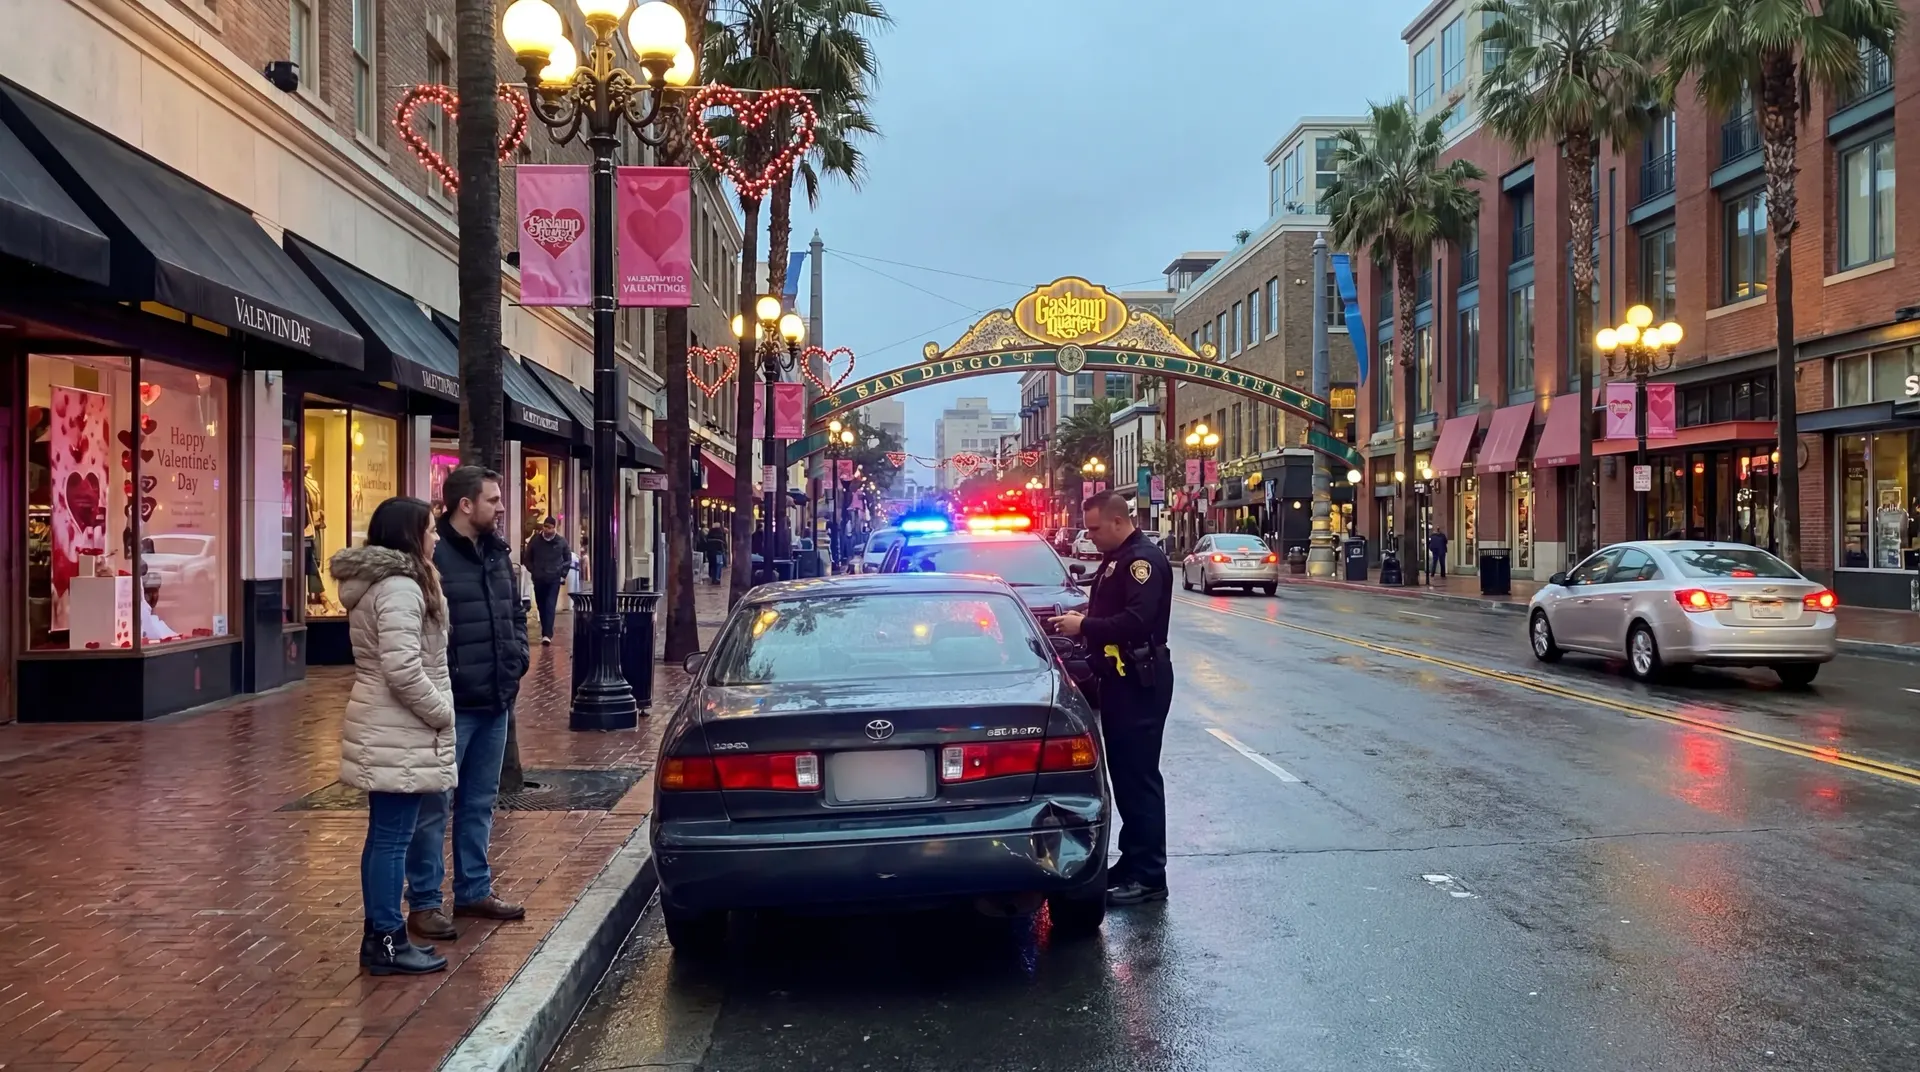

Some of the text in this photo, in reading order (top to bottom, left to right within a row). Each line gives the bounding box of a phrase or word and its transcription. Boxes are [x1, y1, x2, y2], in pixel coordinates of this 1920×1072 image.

[1035, 291, 1106, 325] Gaslamp
[1046, 315, 1101, 339] Quarter
[856, 373, 904, 398] SAN
[920, 354, 1002, 379] DIEGO
[170, 426, 205, 452] Happy
[157, 448, 217, 471] Valentine's
[177, 473, 198, 495] Day
